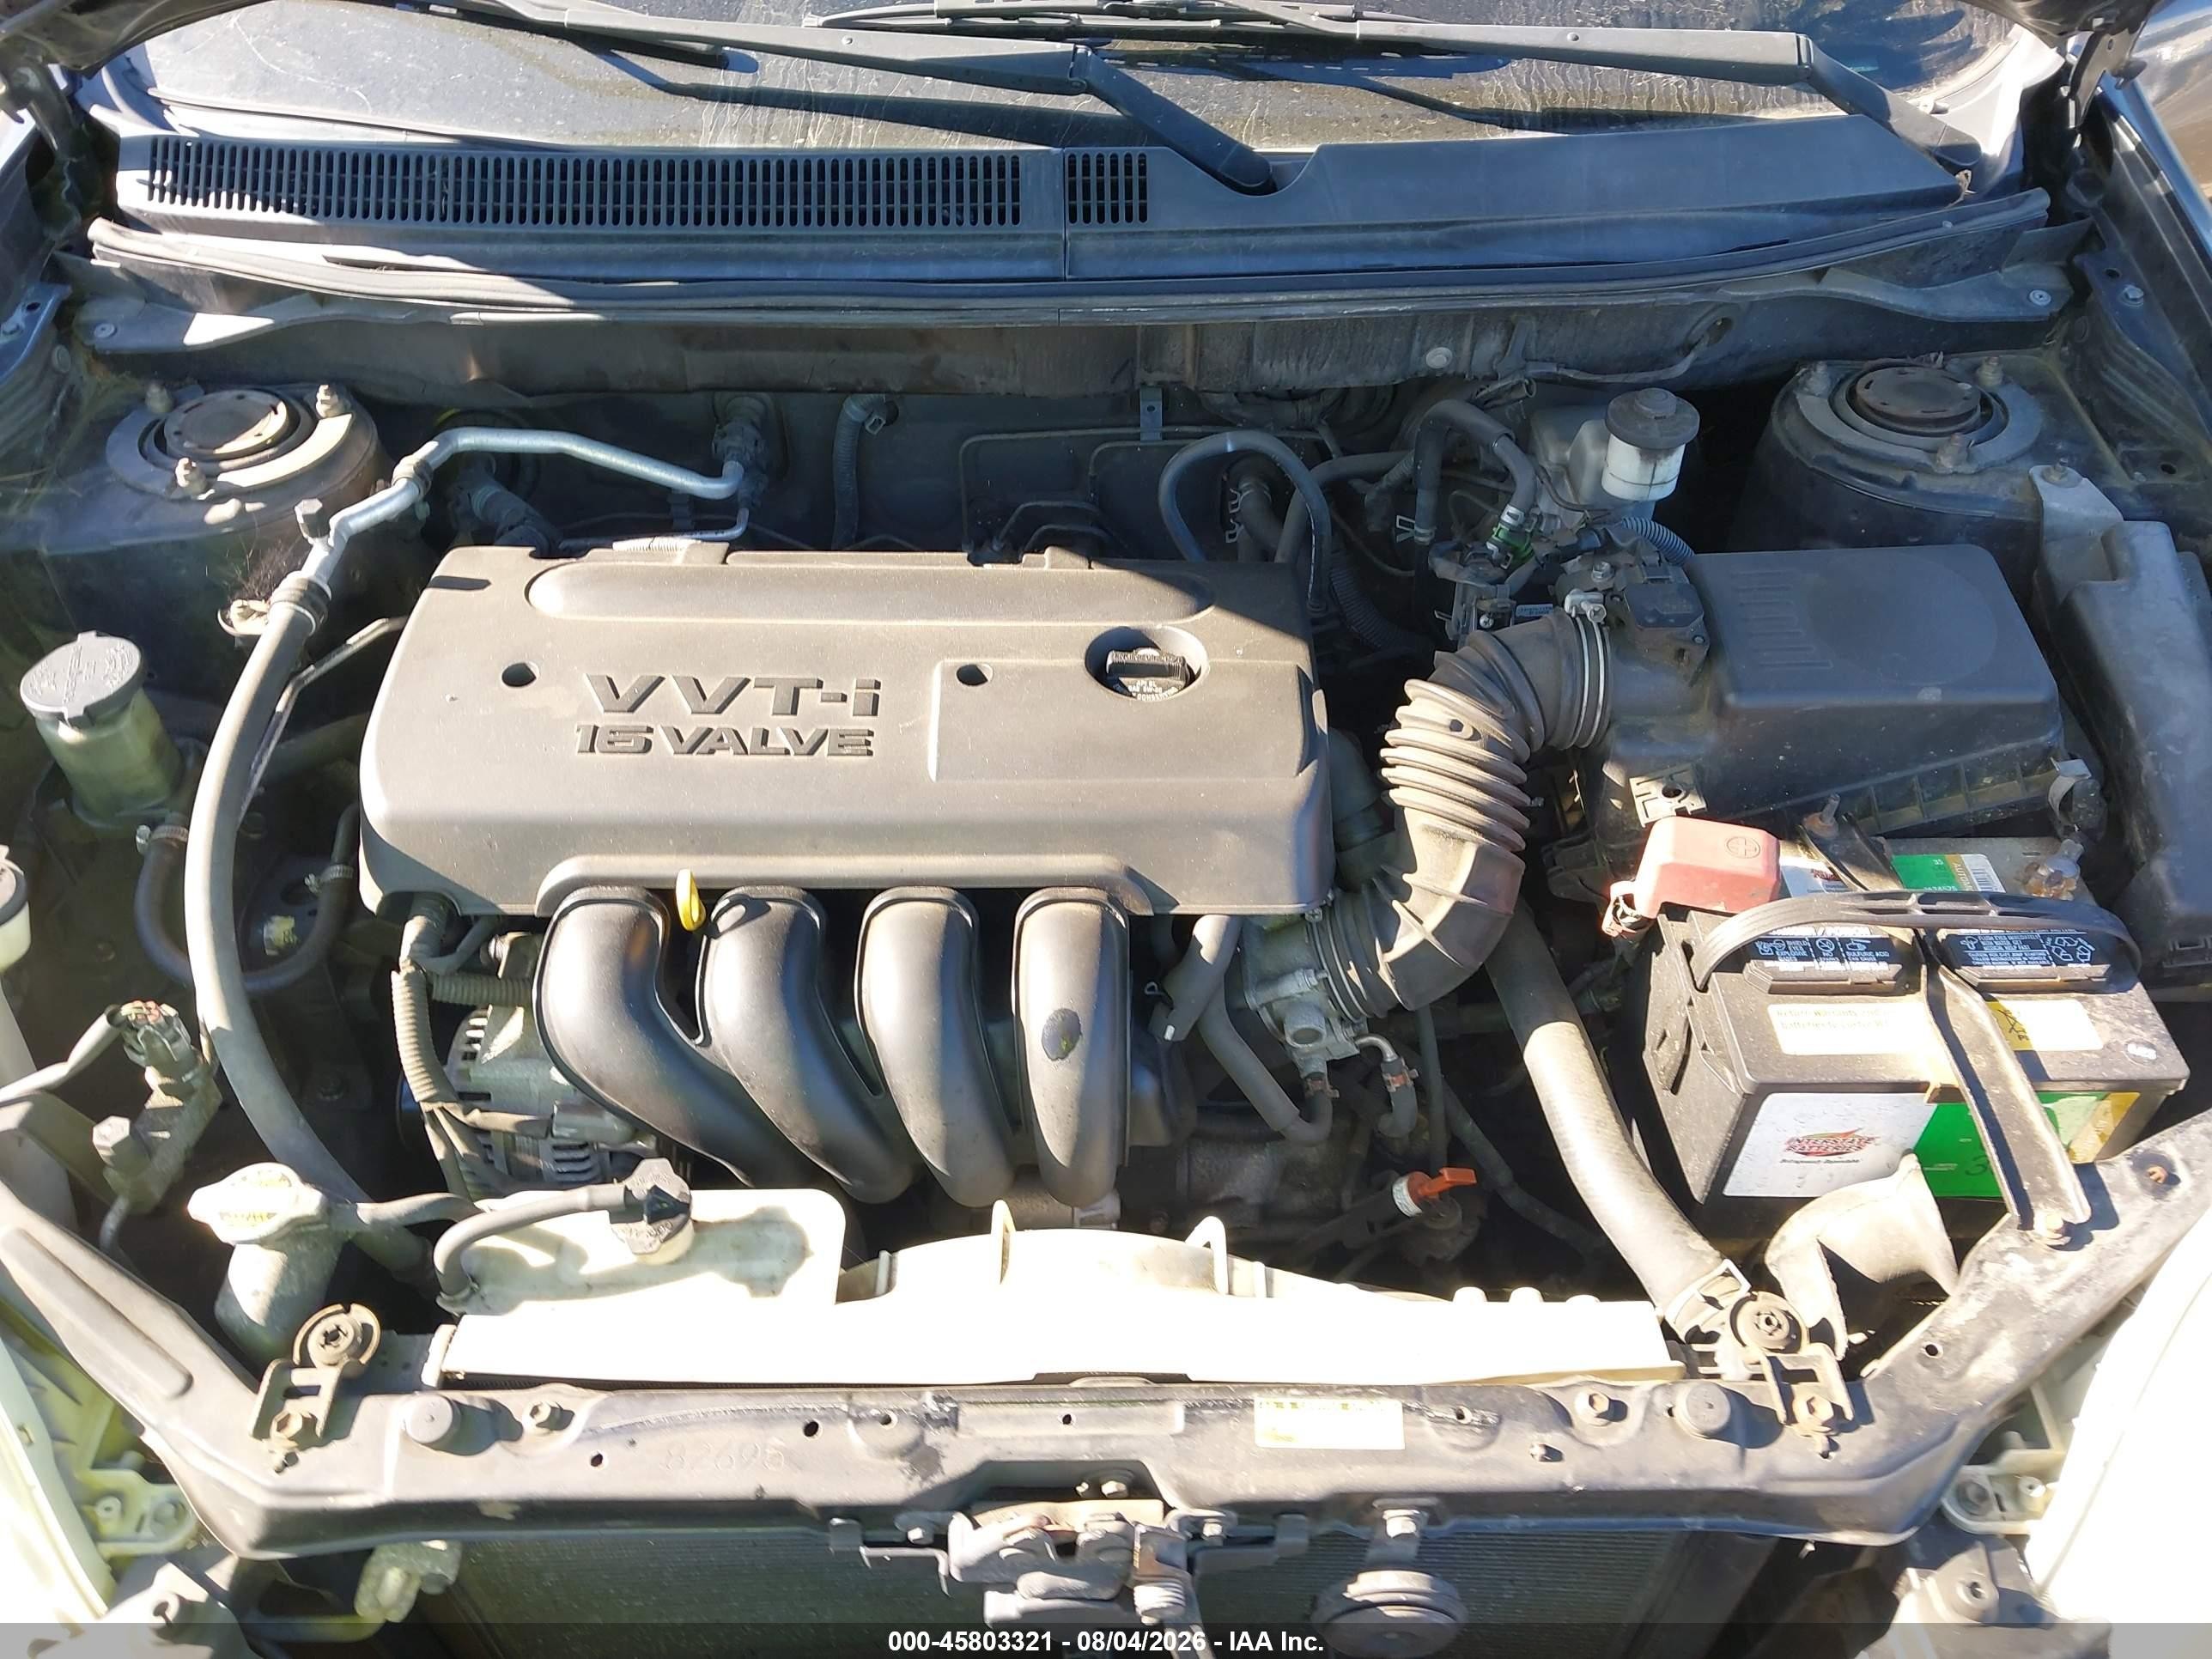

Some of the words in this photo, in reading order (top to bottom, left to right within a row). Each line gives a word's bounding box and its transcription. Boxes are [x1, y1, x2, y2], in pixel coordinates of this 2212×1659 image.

[586, 674, 881, 716] VVT-i
[577, 725, 653, 754] 16
[659, 726, 875, 756] VALVE
